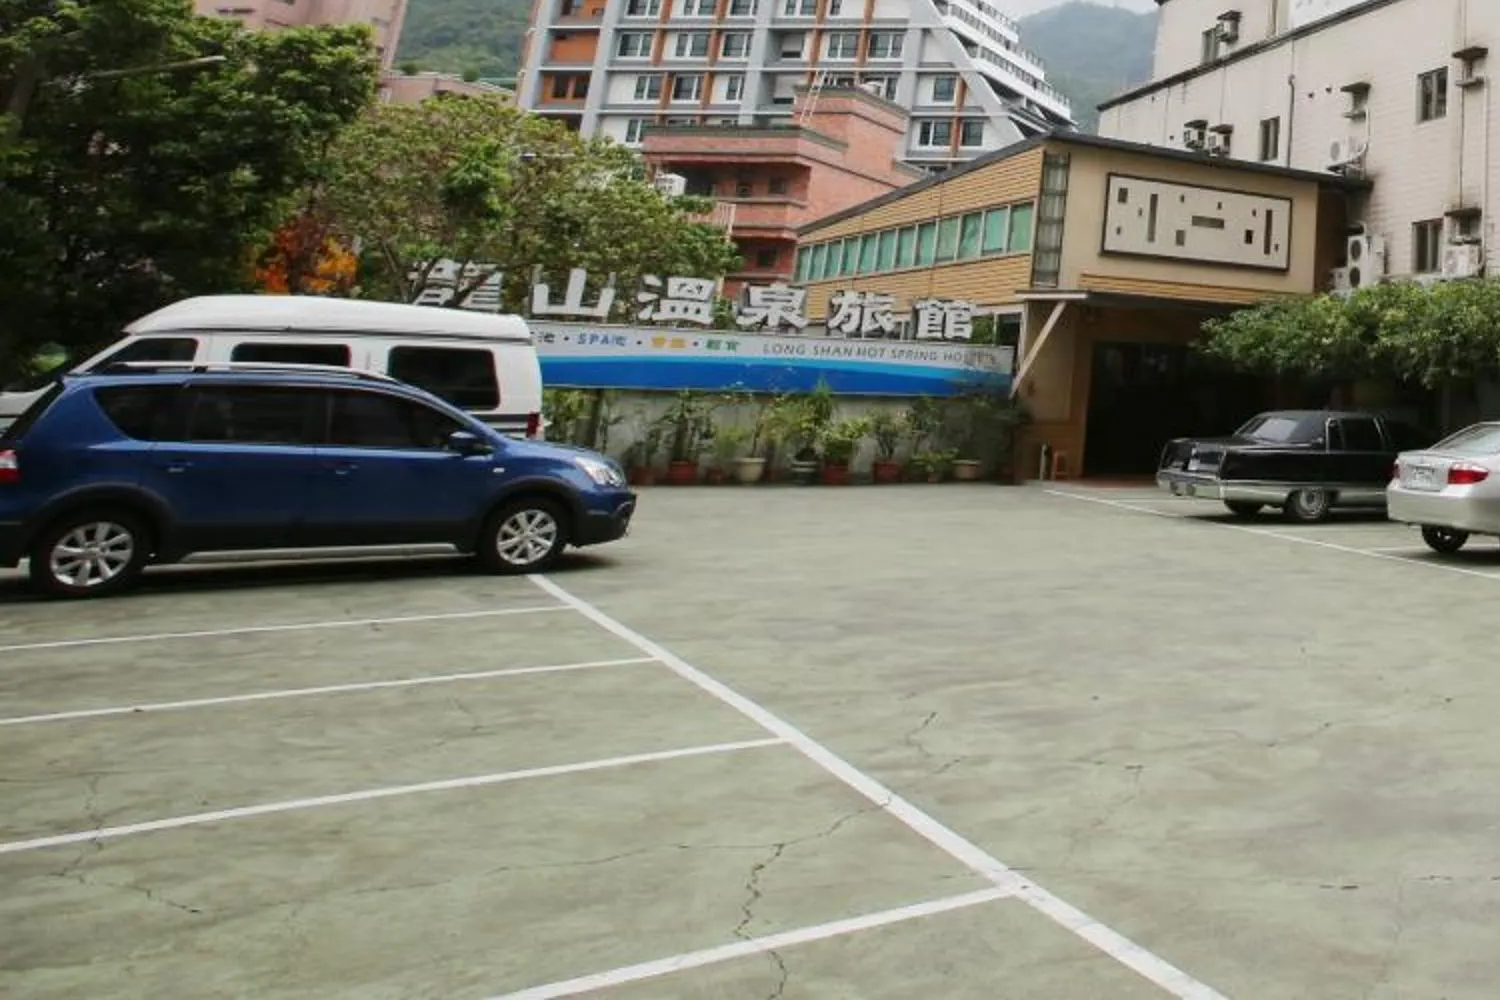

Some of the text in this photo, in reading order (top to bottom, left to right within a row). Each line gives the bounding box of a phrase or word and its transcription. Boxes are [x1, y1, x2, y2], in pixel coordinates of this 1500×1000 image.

[763, 343, 805, 356] LONG
[813, 345, 853, 359] SHAN
[855, 347, 886, 360] HOT
[891, 349, 937, 362] SPRING
